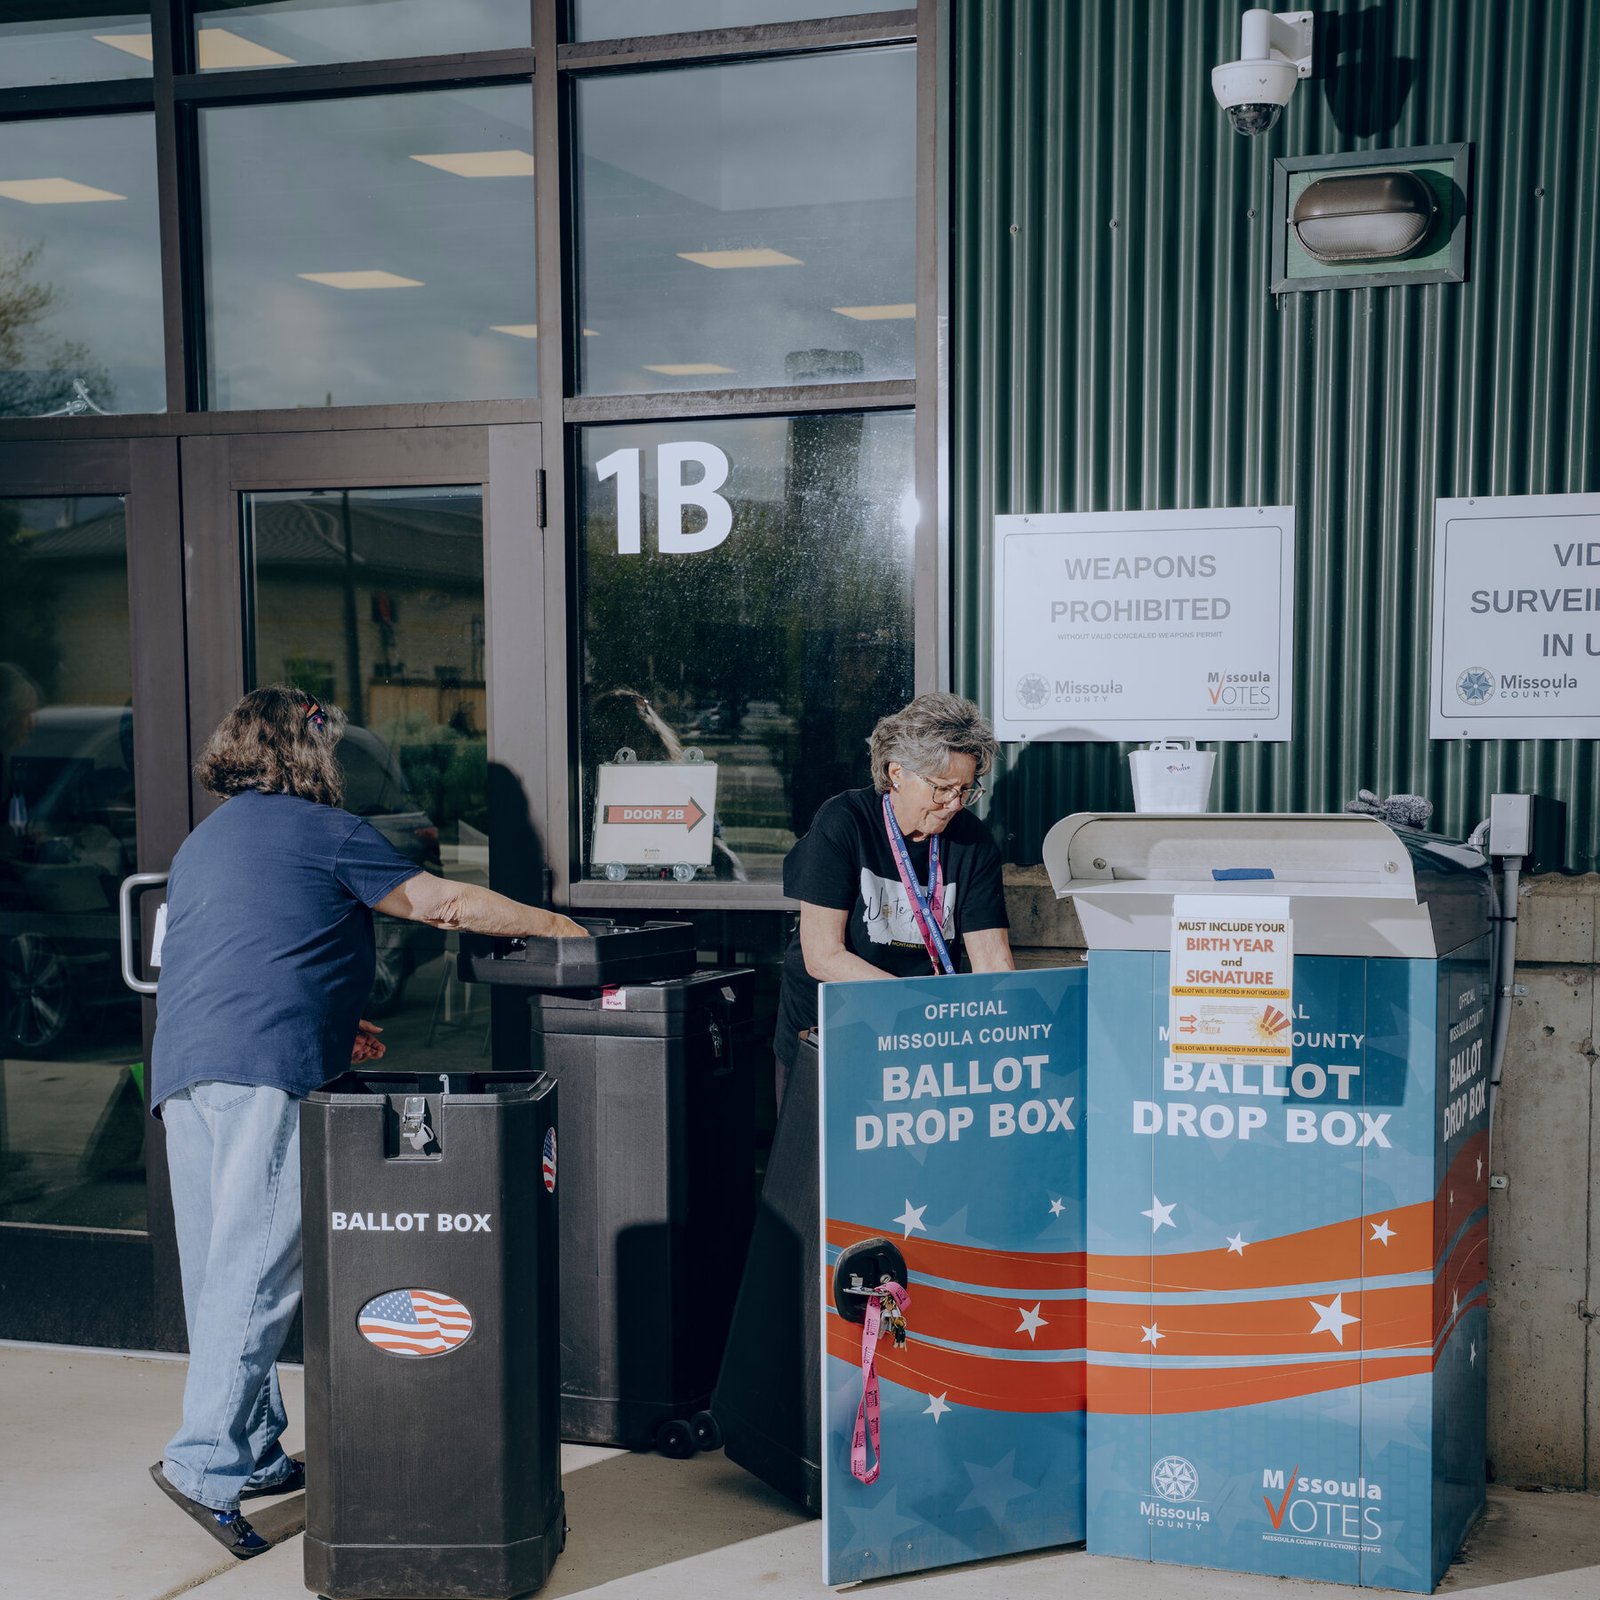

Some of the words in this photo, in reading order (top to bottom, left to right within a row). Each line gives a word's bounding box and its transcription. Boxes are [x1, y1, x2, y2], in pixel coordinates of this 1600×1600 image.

[595, 441, 733, 555] 1B
[1064, 553, 1218, 581] WEAPONS
[1050, 597, 1232, 624] PROHIBITED
[1470, 588, 1600, 614] SURVEI
[1057, 633, 1091, 641] WITHOUT
[1113, 632, 1157, 640] CONCEALED
[1158, 631, 1195, 639] WEAPONS
[1196, 631, 1223, 639] PERMIT
[1542, 633, 1573, 657] IN
[1055, 679, 1124, 695] Missoula
[1500, 673, 1578, 690] Missoula
[1055, 695, 1109, 703] COUNTY
[1208, 685, 1271, 705] VOTES
[1500, 690, 1561, 699] COUNTY
[623, 809, 663, 820] DOOR
[666, 809, 685, 820] 2B
[1178, 922, 1207, 932] MUST
[1209, 922, 1253, 932] INCLUDE
[1255, 923, 1286, 933] YOUR
[1186, 937, 1230, 951] BIRTH
[1232, 938, 1274, 952] YEAR
[1221, 957, 1243, 967] and
[1186, 969, 1274, 985] SIGNATURE
[924, 999, 1008, 1020] OFFICIAL
[1458, 988, 1476, 1011] OFFICIAL
[878, 1029, 974, 1052] MISSOULA
[979, 1023, 1053, 1045] COUNTY
[1292, 1031, 1365, 1050] OUNTY
[1450, 1038, 1483, 1093] BALLOT
[883, 1054, 1050, 1102] BALLOT
[1163, 1057, 1361, 1100] BALLOT
[1443, 1093, 1467, 1143] DROP
[1469, 1077, 1487, 1121] BOX
[855, 1106, 974, 1151] DROP
[989, 1096, 1076, 1138] BOX
[1132, 1100, 1268, 1140] DROP
[1286, 1108, 1393, 1149] BOX
[331, 1211, 430, 1232] BALLOT
[437, 1212, 492, 1233] BOX
[1139, 1500, 1210, 1523] Missoula
[1263, 1497, 1382, 1541] VOTES
[1147, 1518, 1203, 1531] COUNTY
[1262, 1534, 1295, 1544] MISSOULA
[1295, 1538, 1322, 1547] COUNTY
[1323, 1541, 1357, 1551] ELECTIONS
[1358, 1545, 1382, 1554] OFFICE
